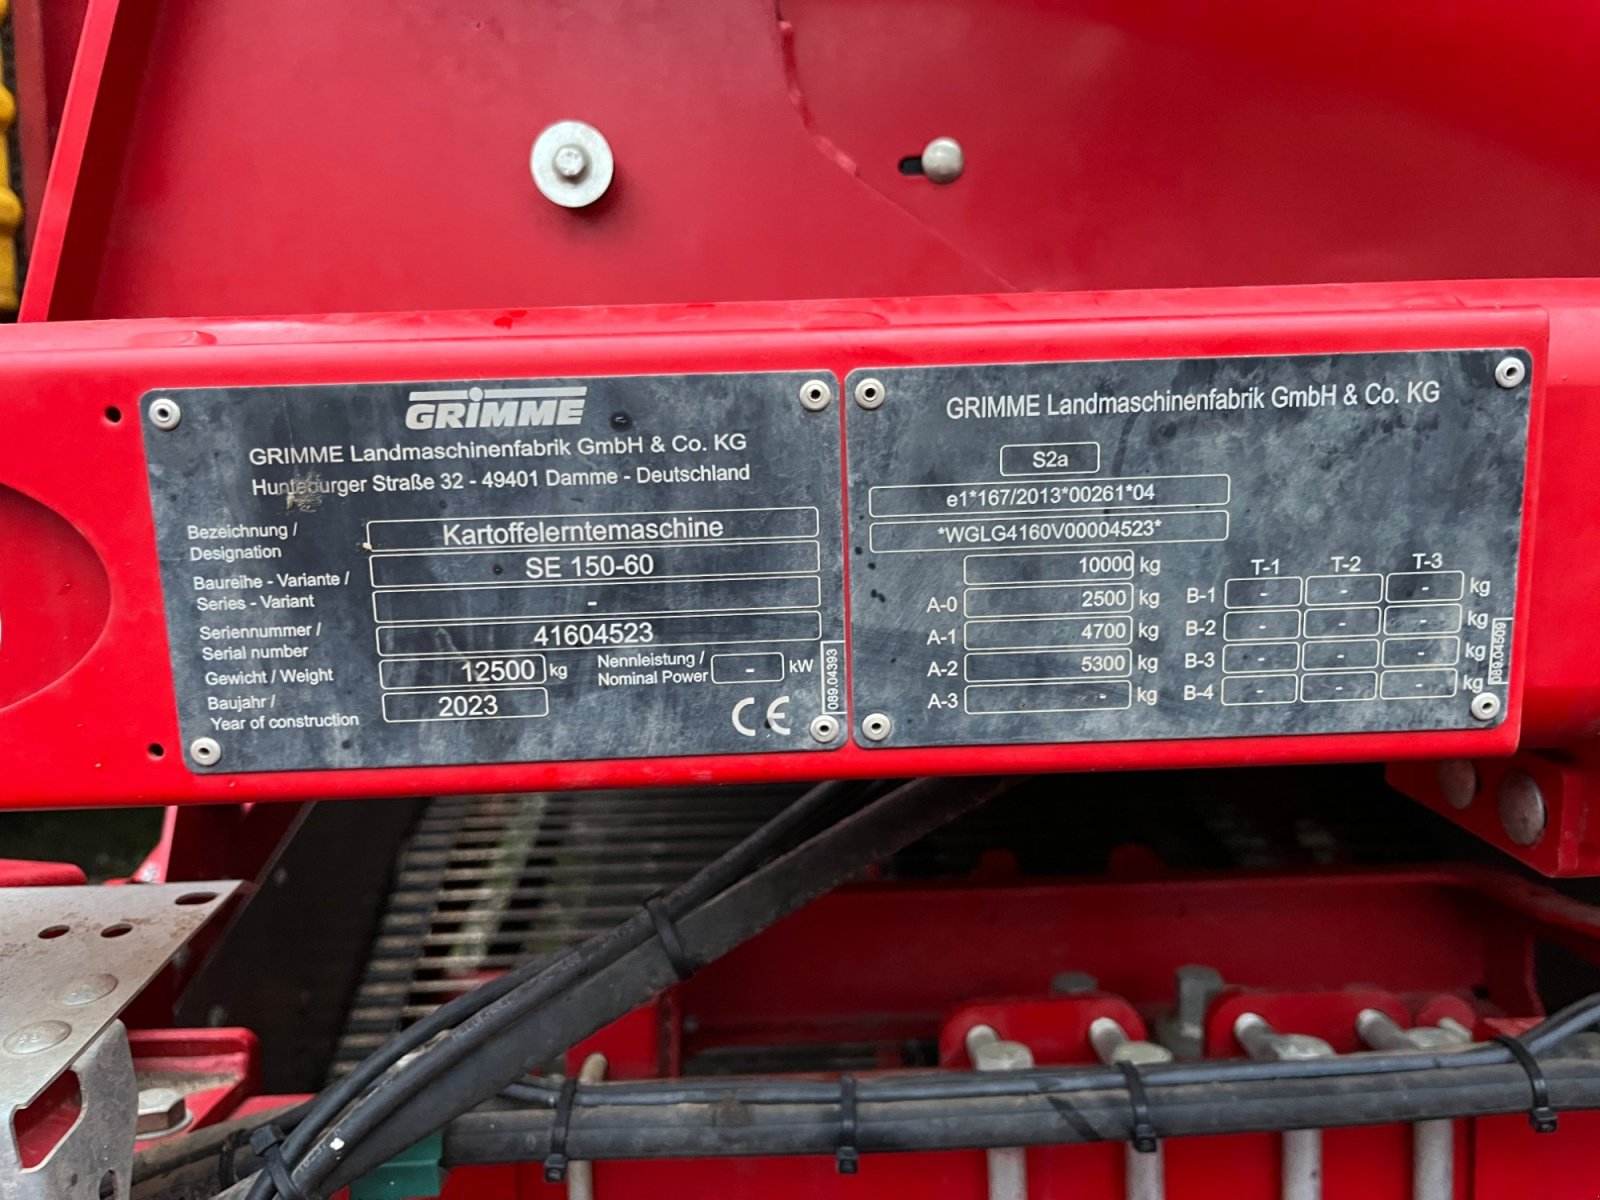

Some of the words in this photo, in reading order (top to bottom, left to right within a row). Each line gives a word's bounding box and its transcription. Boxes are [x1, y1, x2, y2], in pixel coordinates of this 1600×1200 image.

[405, 387, 587, 429] GRIMME
[946, 395, 1040, 419] GRIMME
[1048, 388, 1265, 416] Landmaschinenfabrik
[1271, 384, 1337, 408] GmbH
[1343, 383, 1358, 406] &
[1365, 382, 1399, 405] Co.
[1407, 381, 1440, 403] KG
[249, 446, 344, 466] GRIMME
[350, 439, 571, 463] Landmaschinenfabrik
[577, 436, 643, 455] GmbH
[651, 436, 665, 453] &
[672, 435, 707, 452] Co.
[714, 433, 747, 450] KG
[1032, 452, 1069, 468] S2a
[372, 473, 435, 492] Straße
[440, 473, 463, 490] 32
[482, 470, 539, 488] 49401
[546, 468, 618, 486] Damme
[637, 464, 750, 483] Deutschland
[187, 523, 288, 540] Bezeichnung
[292, 522, 298, 536] /
[443, 517, 724, 546] Kartoffelerntemaschine
[190, 546, 282, 562] Designation
[1079, 555, 1133, 573] 10000
[1140, 557, 1161, 575] kg
[1251, 559, 1280, 575] T-1
[1331, 556, 1361, 572] T-2
[1412, 553, 1443, 569] T-3
[525, 556, 561, 579] SE
[571, 554, 654, 577] 150-60
[193, 574, 263, 590] Baureihe
[276, 573, 341, 588] Variante
[344, 571, 350, 585] /
[1187, 587, 1216, 603] B-1
[1470, 578, 1491, 596] kg
[197, 597, 246, 611] Series
[260, 595, 315, 609] Variant
[926, 597, 958, 613] A-0
[1081, 590, 1127, 608] 2500
[1139, 590, 1160, 608] kg
[200, 625, 313, 640] Seriennummer
[315, 622, 321, 637] /
[534, 622, 654, 646] 41604523
[926, 629, 957, 645] A-1
[1081, 623, 1126, 640] 4700
[1138, 622, 1160, 641] kg
[1185, 620, 1216, 636] B-2
[1467, 610, 1489, 629] kg
[202, 646, 247, 660] Serial
[251, 644, 308, 659] number
[597, 652, 696, 669] Nennleistung
[698, 650, 705, 665] /
[1184, 653, 1215, 669] B-3
[1465, 643, 1486, 661] kg
[205, 670, 267, 686] Gewicht
[280, 668, 334, 685] Weight
[461, 660, 535, 682] 12500
[550, 663, 568, 680] kg
[789, 659, 814, 673] kW
[927, 661, 959, 677] A-2
[1081, 655, 1126, 672] 5300
[1137, 655, 1159, 673] kg
[598, 671, 658, 686] Nominal
[663, 669, 709, 684] Power
[826, 648, 838, 710] 089.04393
[1183, 685, 1214, 700] B-4
[1463, 675, 1484, 693] kg
[208, 696, 267, 713] Baujahr
[270, 695, 276, 709] /
[438, 695, 499, 717] 2023
[927, 693, 959, 710] A-3
[1137, 687, 1158, 705] kg
[210, 717, 245, 731] Year
[252, 716, 265, 729] of
[268, 714, 360, 729] construction
